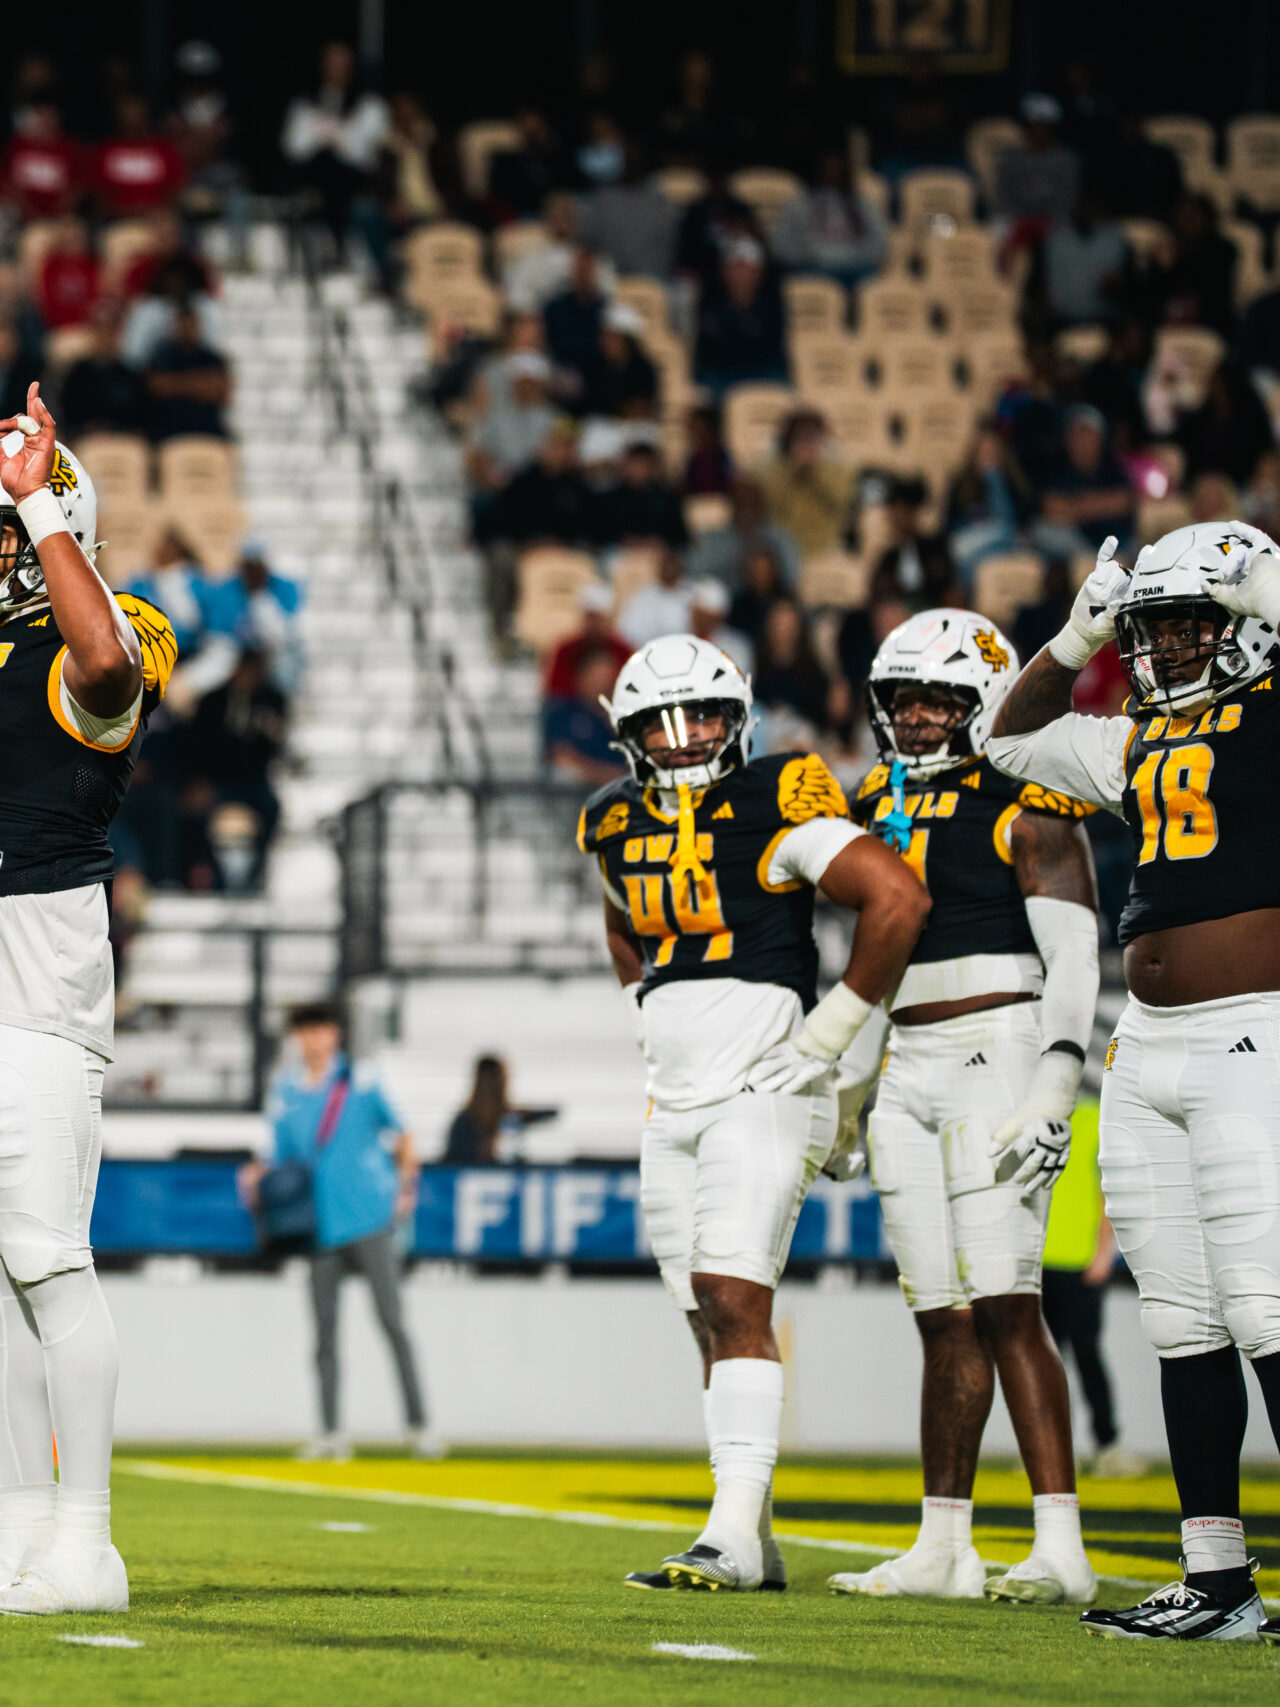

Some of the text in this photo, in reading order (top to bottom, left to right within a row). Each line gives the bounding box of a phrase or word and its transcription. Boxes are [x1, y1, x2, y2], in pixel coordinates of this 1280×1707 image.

[1143, 703, 1244, 741] OWLS
[1130, 743, 1219, 867] 18
[623, 833, 714, 863] OWS
[620, 870, 733, 968] 44
[1186, 1519, 1240, 1529] Supreme
